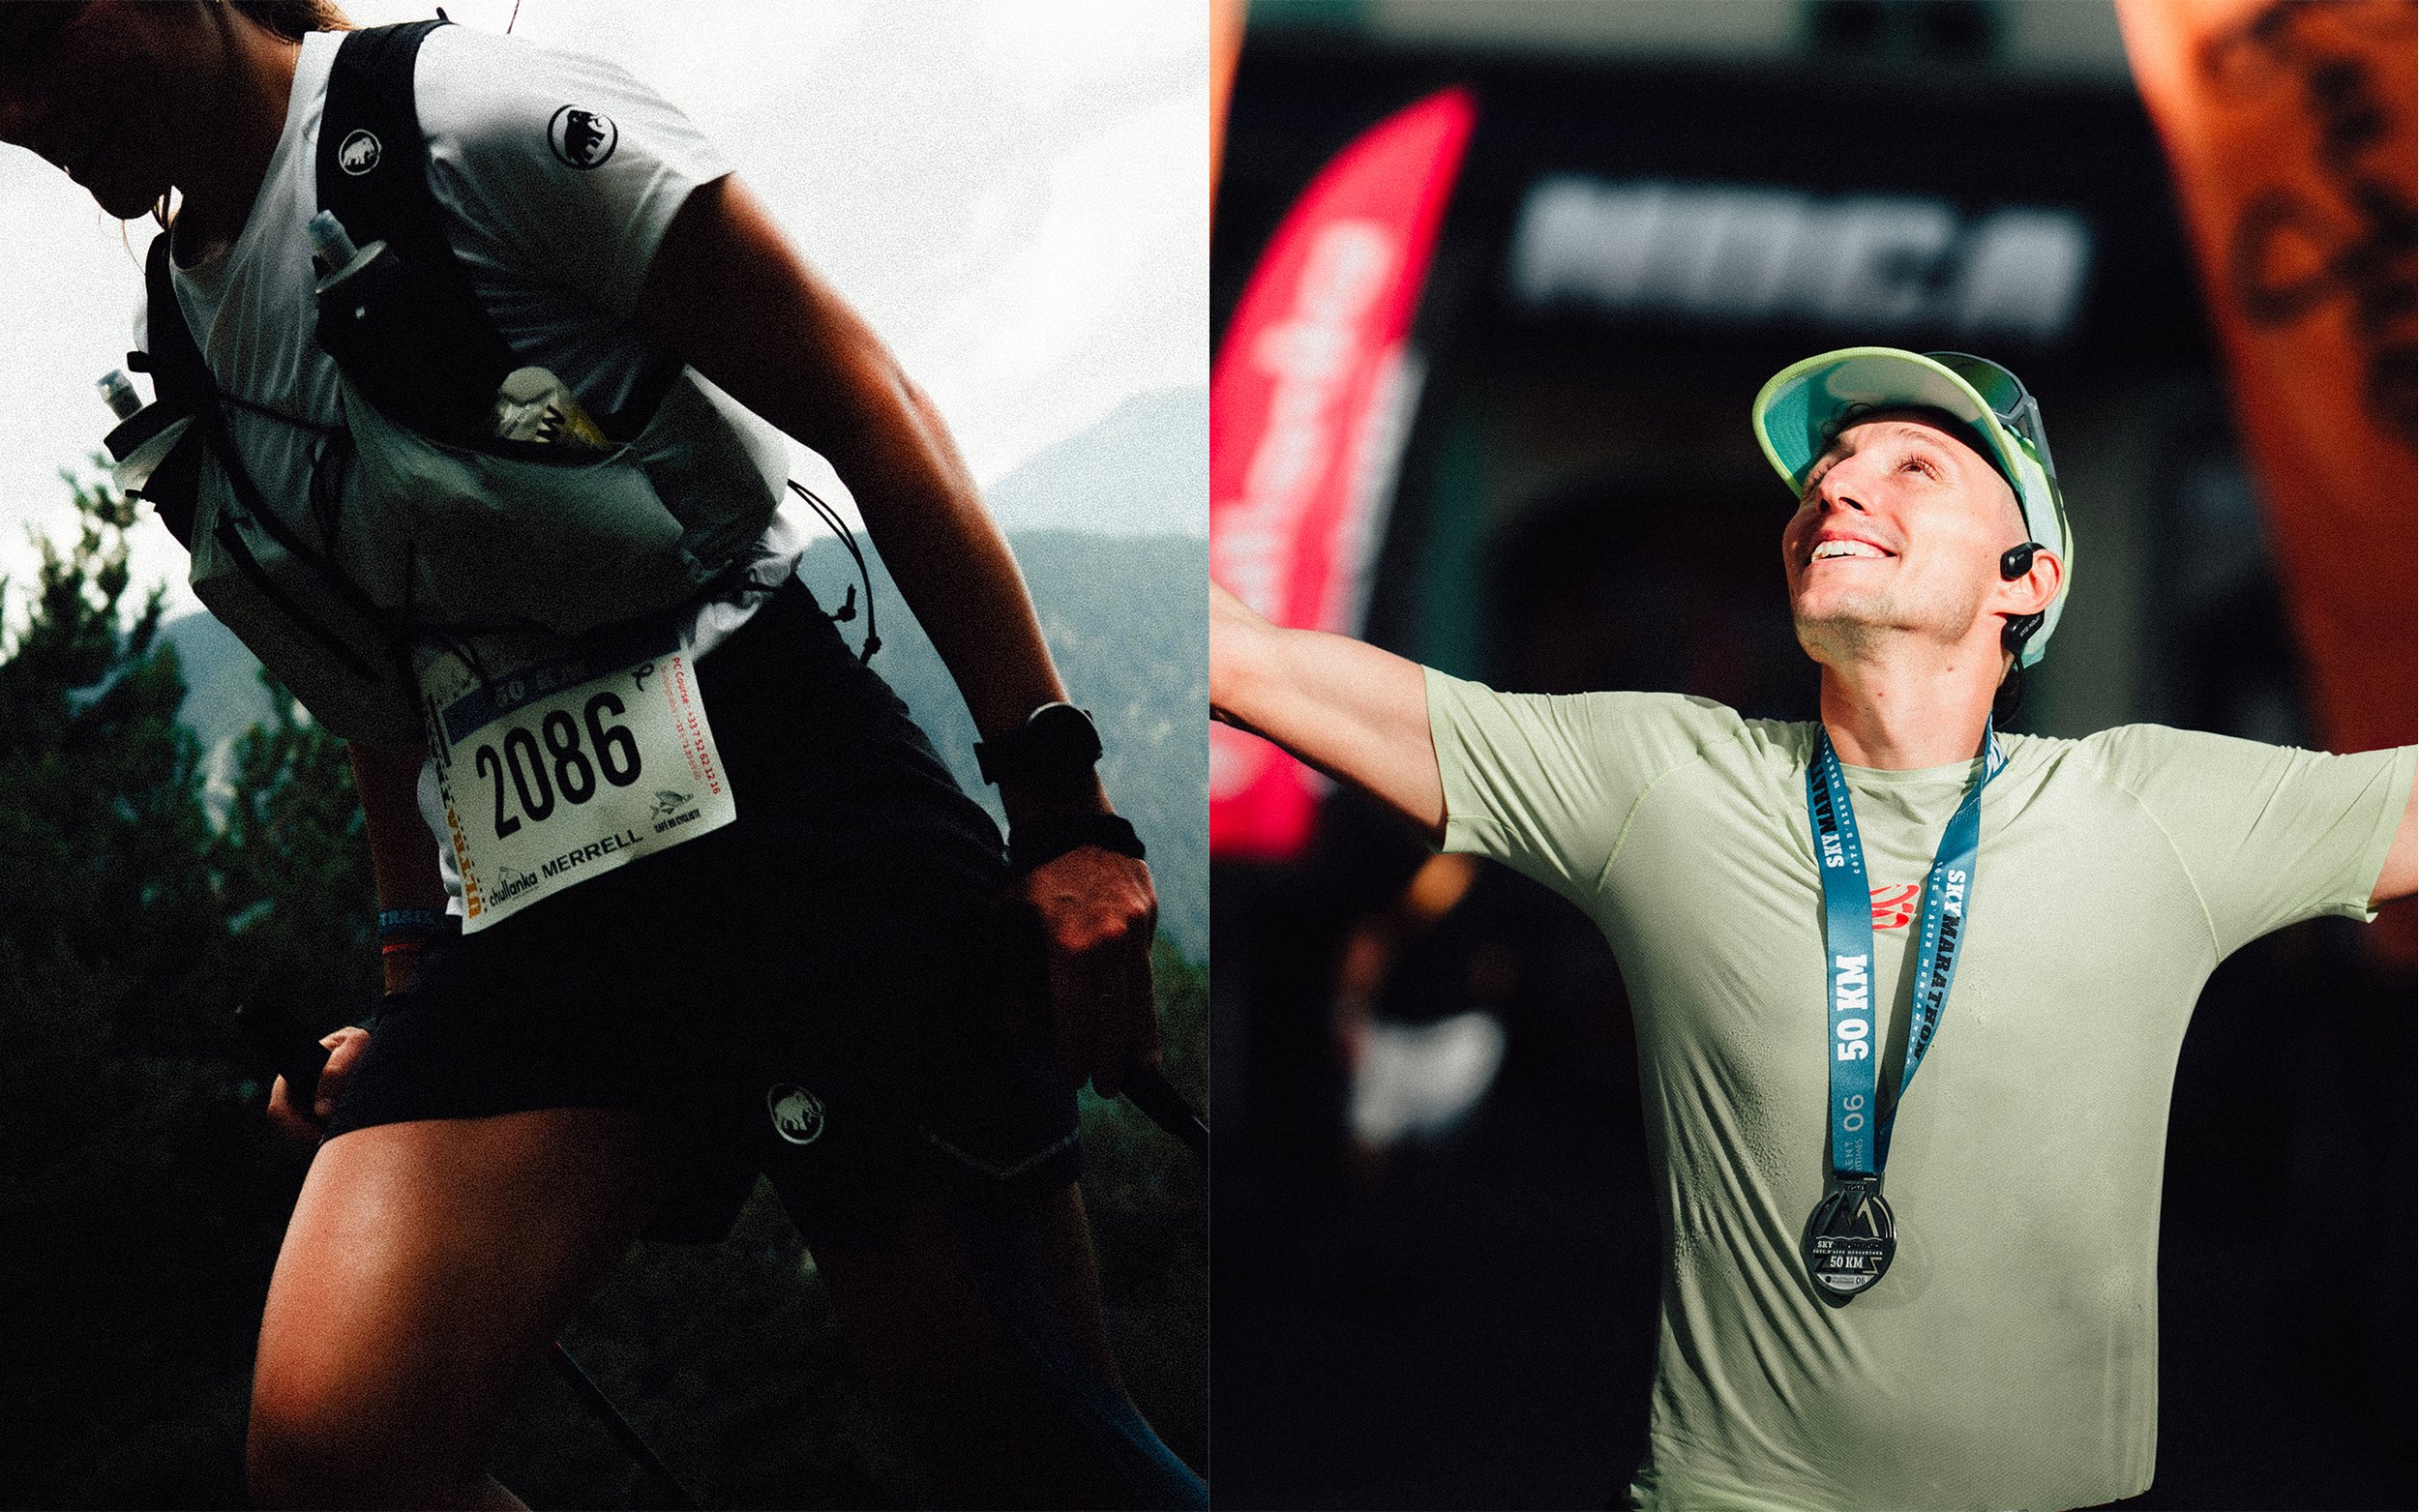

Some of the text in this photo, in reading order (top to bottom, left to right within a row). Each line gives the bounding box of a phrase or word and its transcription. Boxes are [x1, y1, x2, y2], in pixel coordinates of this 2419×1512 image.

[672, 656, 682, 670] PC
[675, 671, 690, 704] Course
[688, 711, 698, 730] +33
[695, 738, 705, 752] 52
[475, 690, 642, 842] 2086
[700, 753, 710, 767] 62
[704, 766, 716, 781] 12
[710, 781, 721, 795] 16
[541, 829, 644, 879] MERRELL
[490, 871, 538, 907] chullanka
[1913, 870, 1966, 1061] SKYMARATHON
[1836, 954, 1869, 1060] 50 KM
[1843, 1094, 1866, 1133] 06
[1830, 1256, 1863, 1268] 50 KM
